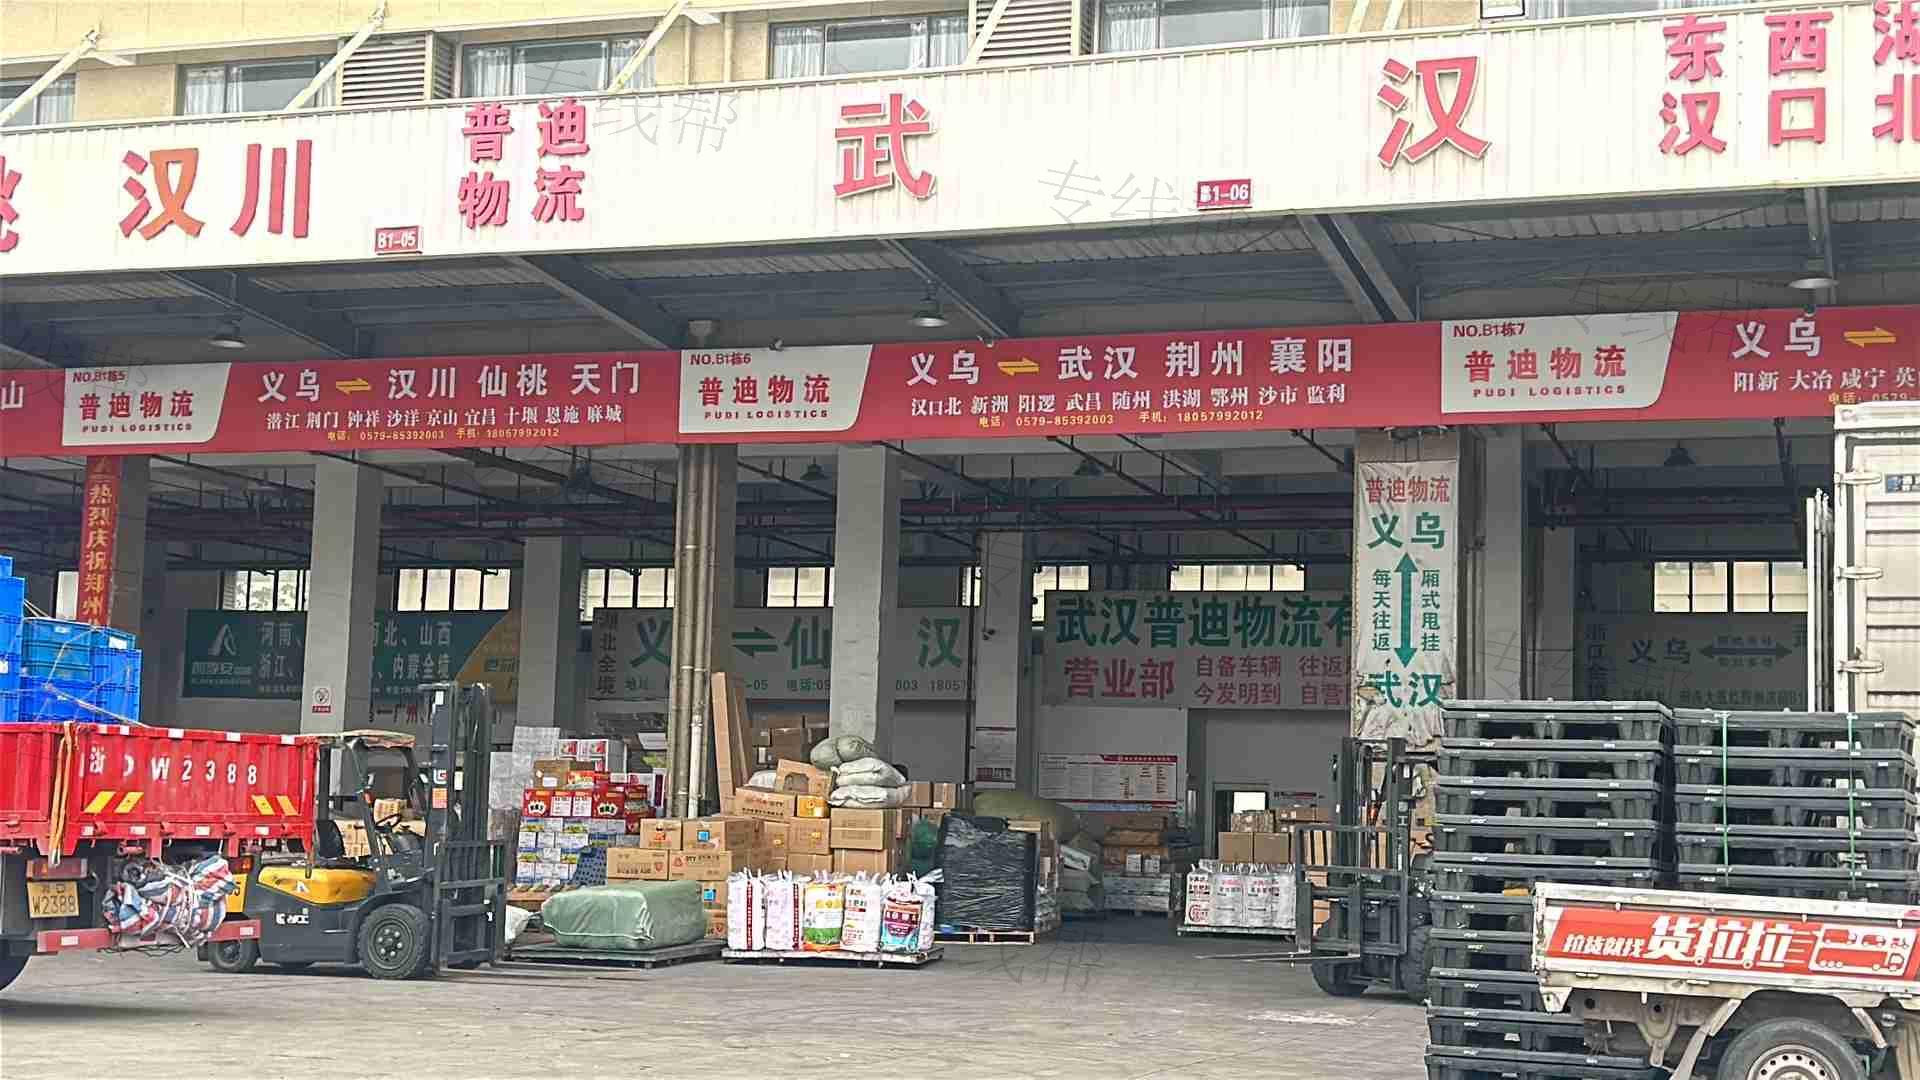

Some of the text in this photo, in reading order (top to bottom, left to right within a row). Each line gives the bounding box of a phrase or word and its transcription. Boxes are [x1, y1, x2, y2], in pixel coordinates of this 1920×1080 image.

[834, 56, 1492, 199] 武 汉
[119, 139, 313, 240] 汉川
[377, 231, 417, 249] B1-05
[1732, 317, 1822, 360] 义乌
[906, 338, 1353, 386] 义乌 武汉 荆州 襄阳
[1464, 345, 1627, 383] 普迪物流
[258, 361, 640, 402] 义乌 汉川 仙桃 天门
[698, 374, 831, 407] 普迪物流
[1472, 385, 1626, 398] PUDI LOGISTICS
[1733, 370, 1779, 393] 阳新
[80, 389, 194, 420] 普迪物流
[305, 411, 339, 429] 荆门
[387, 409, 421, 427] 沙洋
[427, 408, 458, 426] 京山
[465, 407, 496, 425] 宜昌
[545, 404, 580, 423] 恩施
[704, 410, 829, 420] PUDI LOGISTICS
[911, 396, 962, 417] 汉口北
[971, 394, 1008, 414] 新洲
[1065, 392, 1102, 411] 武昌
[1112, 391, 1151, 409] 随州
[1162, 389, 1200, 408] 洪湖
[1210, 387, 1249, 407] 鄂州
[1258, 385, 1297, 405] 沙市
[1307, 384, 1346, 403] 监利
[1016, 414, 1114, 426] 0579-85392003
[1177, 410, 1264, 422] 18057992012
[1366, 477, 1451, 503] 普迪物流
[1367, 512, 1446, 550] 义乌
[1373, 569, 1392, 652] 每天往返
[1421, 568, 1441, 652] 厢式甩挂
[1064, 656, 1176, 700] 营业部
[1195, 655, 1281, 678] 自备车辆
[1194, 682, 1281, 705] 今发明到
[1645, 914, 1794, 968] 货拉拉
